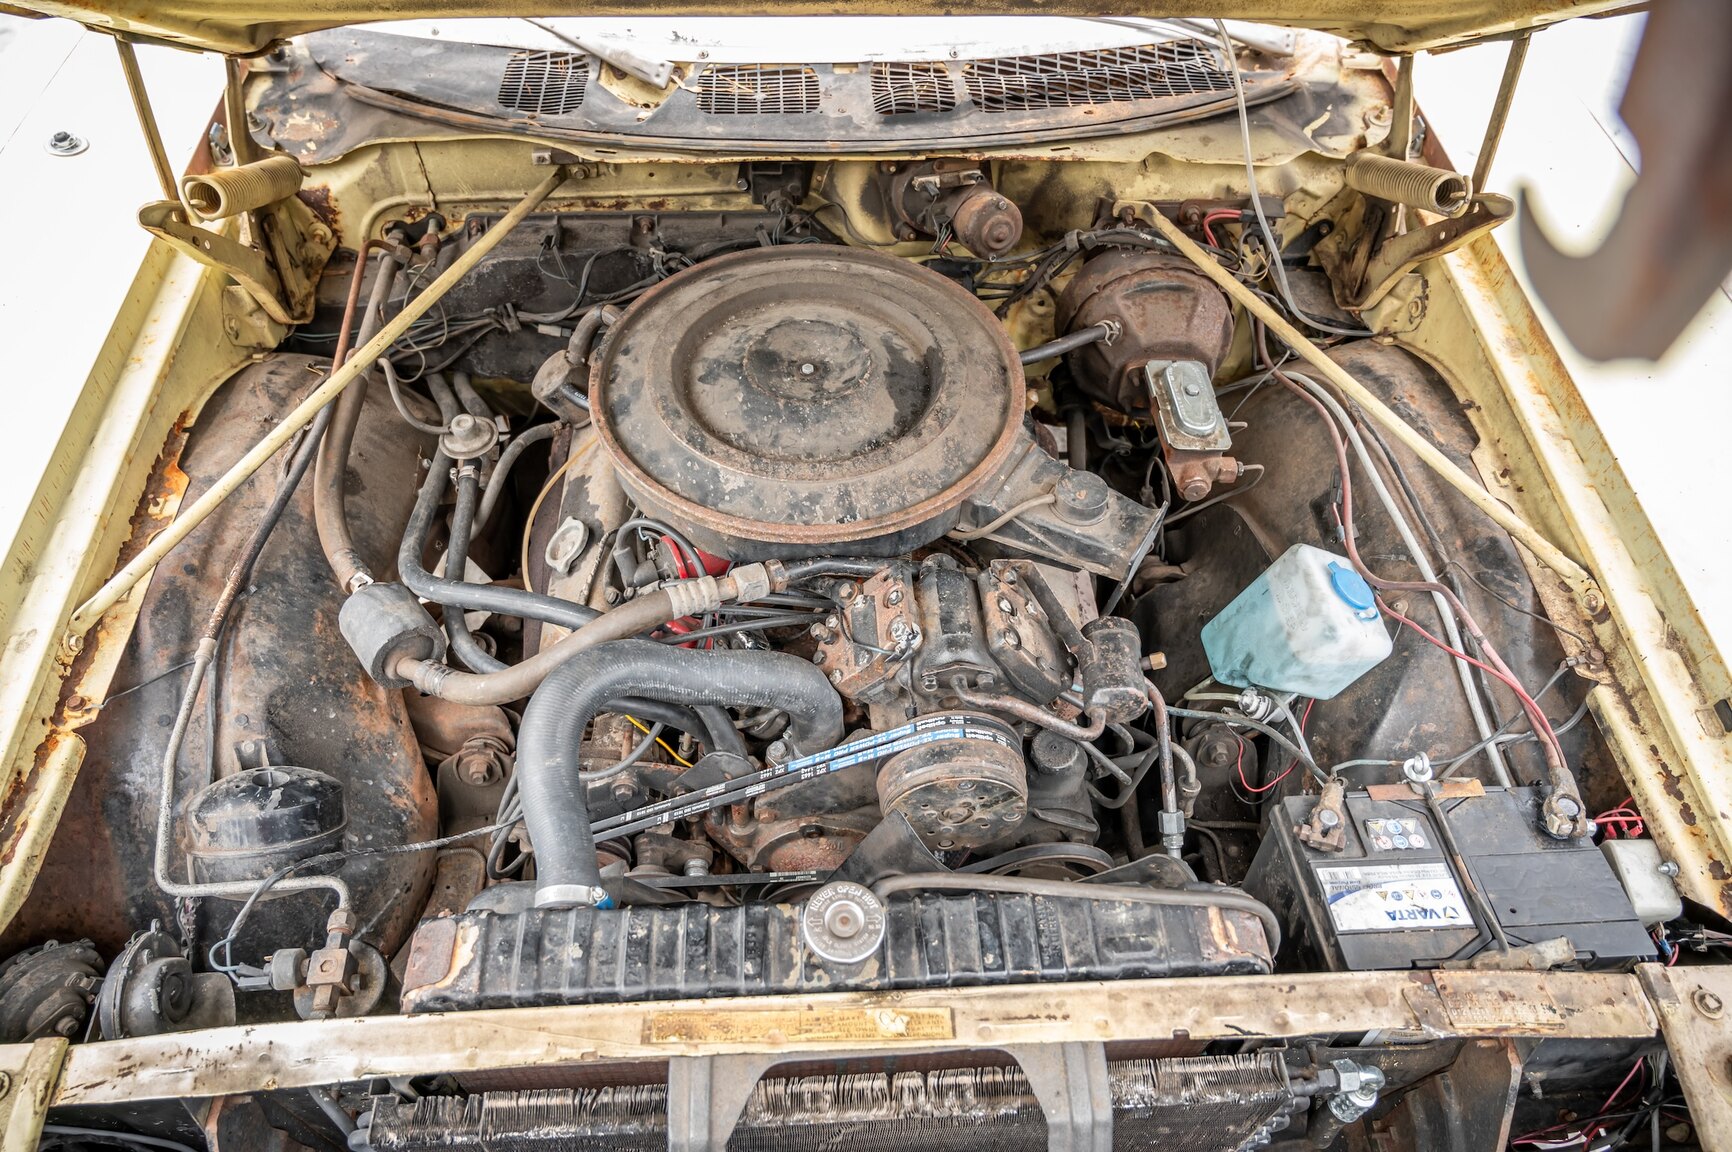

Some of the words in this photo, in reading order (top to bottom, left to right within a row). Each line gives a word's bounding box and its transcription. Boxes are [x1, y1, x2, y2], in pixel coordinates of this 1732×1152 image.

[809, 888, 835, 911] NEVER
[837, 885, 862, 896] OPEN
[862, 893, 879, 909] HOT
[1384, 907, 1441, 921] VARTA
